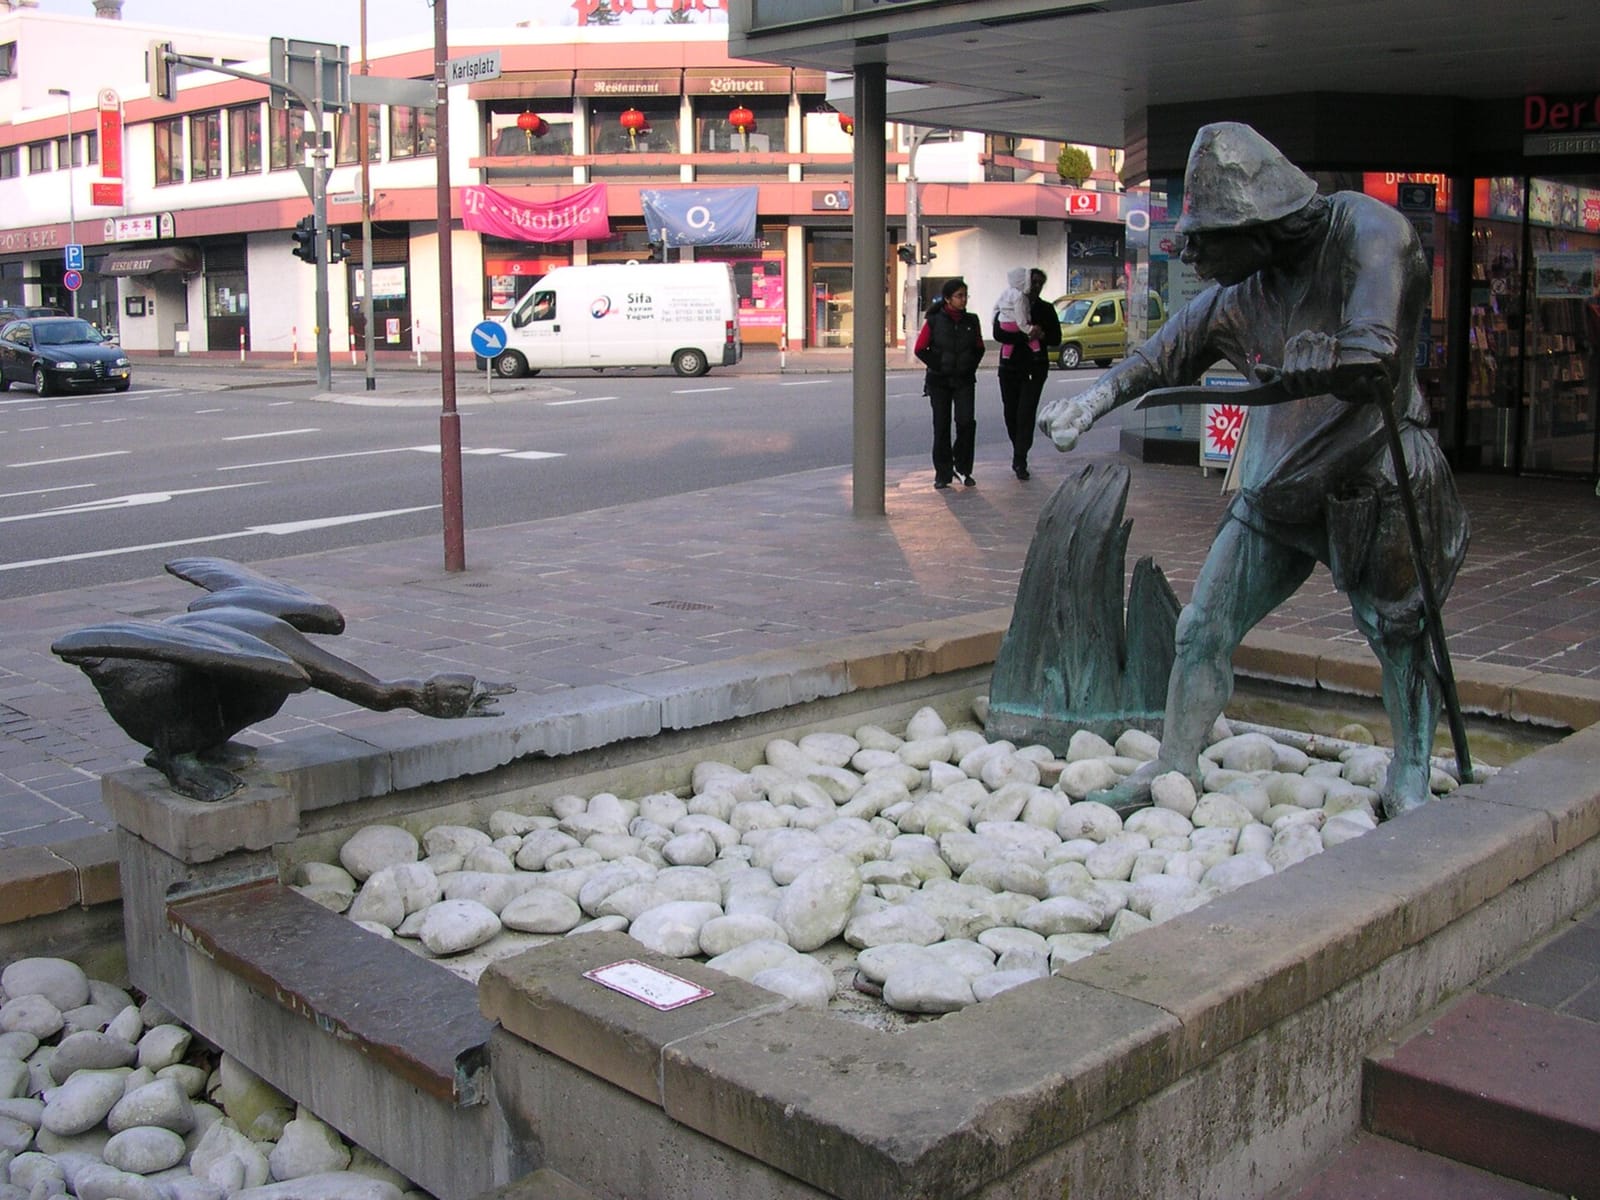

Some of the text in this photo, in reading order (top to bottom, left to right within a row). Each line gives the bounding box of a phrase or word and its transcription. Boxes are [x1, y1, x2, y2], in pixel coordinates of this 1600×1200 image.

[452, 57, 495, 80] Karlsplatz
[594, 77, 764, 93] Restaurant Löwen
[1525, 95, 1587, 129] Der
[686, 206, 717, 232] O2
[69, 247, 79, 262] P
[111, 259, 152, 271] RESTAURANT
[627, 293, 652, 304] Sifa
